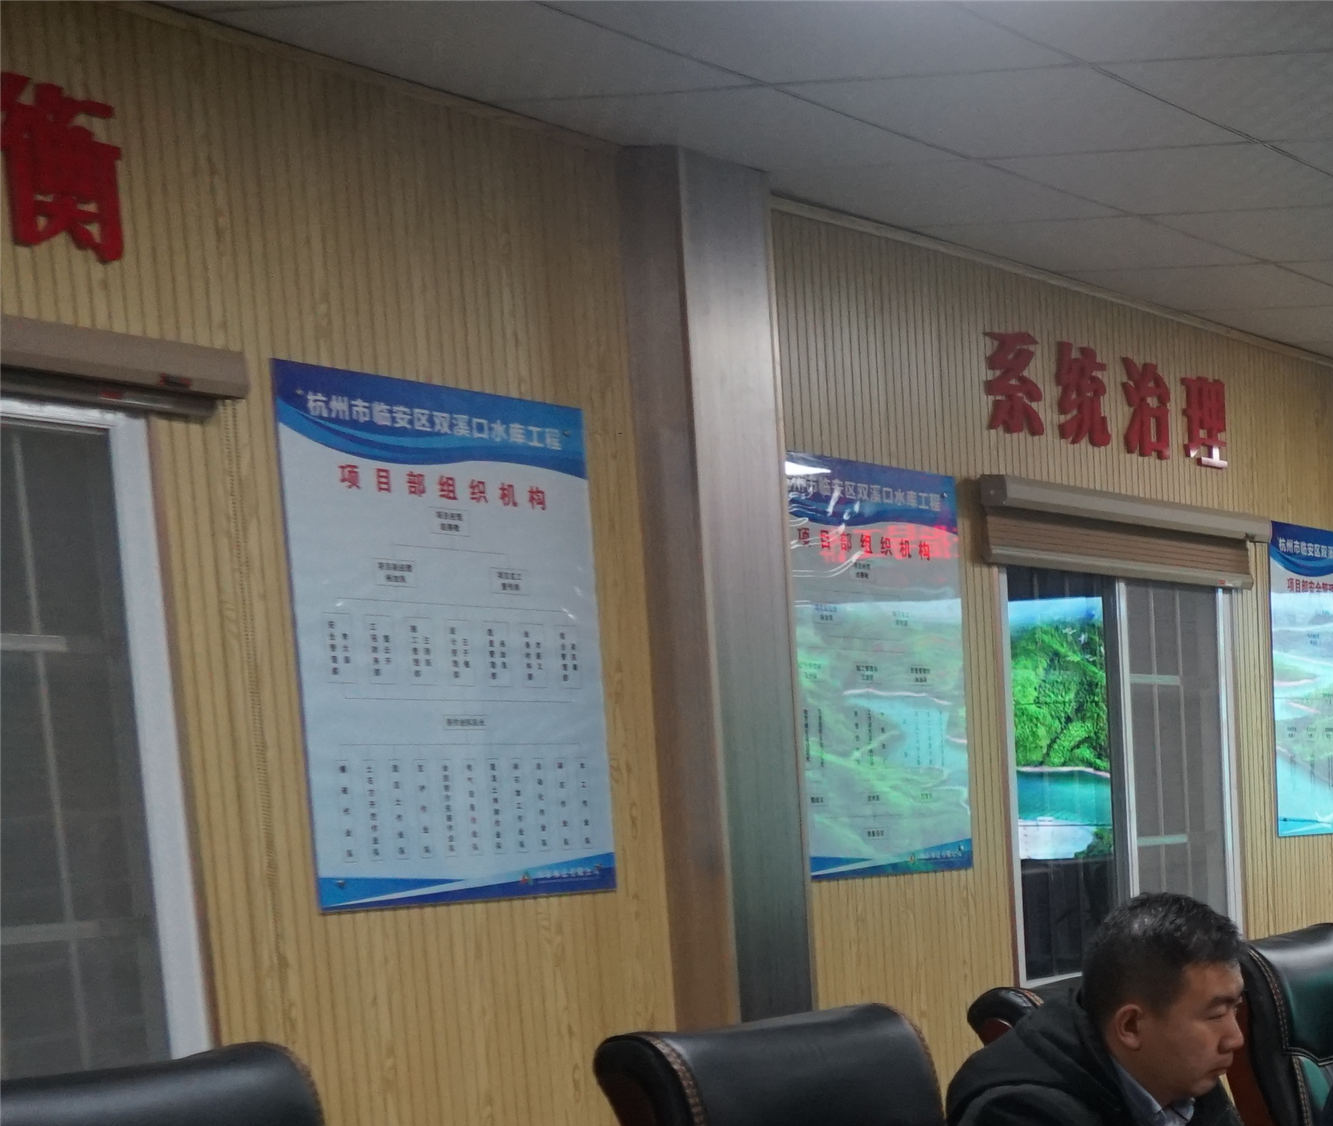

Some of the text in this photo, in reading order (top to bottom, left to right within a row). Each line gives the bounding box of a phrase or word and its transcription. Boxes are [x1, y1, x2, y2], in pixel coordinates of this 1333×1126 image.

[306, 391, 562, 450] 杭州市临安区双溪口水库工程
[982, 331, 1229, 469] 系统治理
[338, 464, 547, 511] 项目部组织机构
[797, 527, 931, 561] 项目部组织机构
